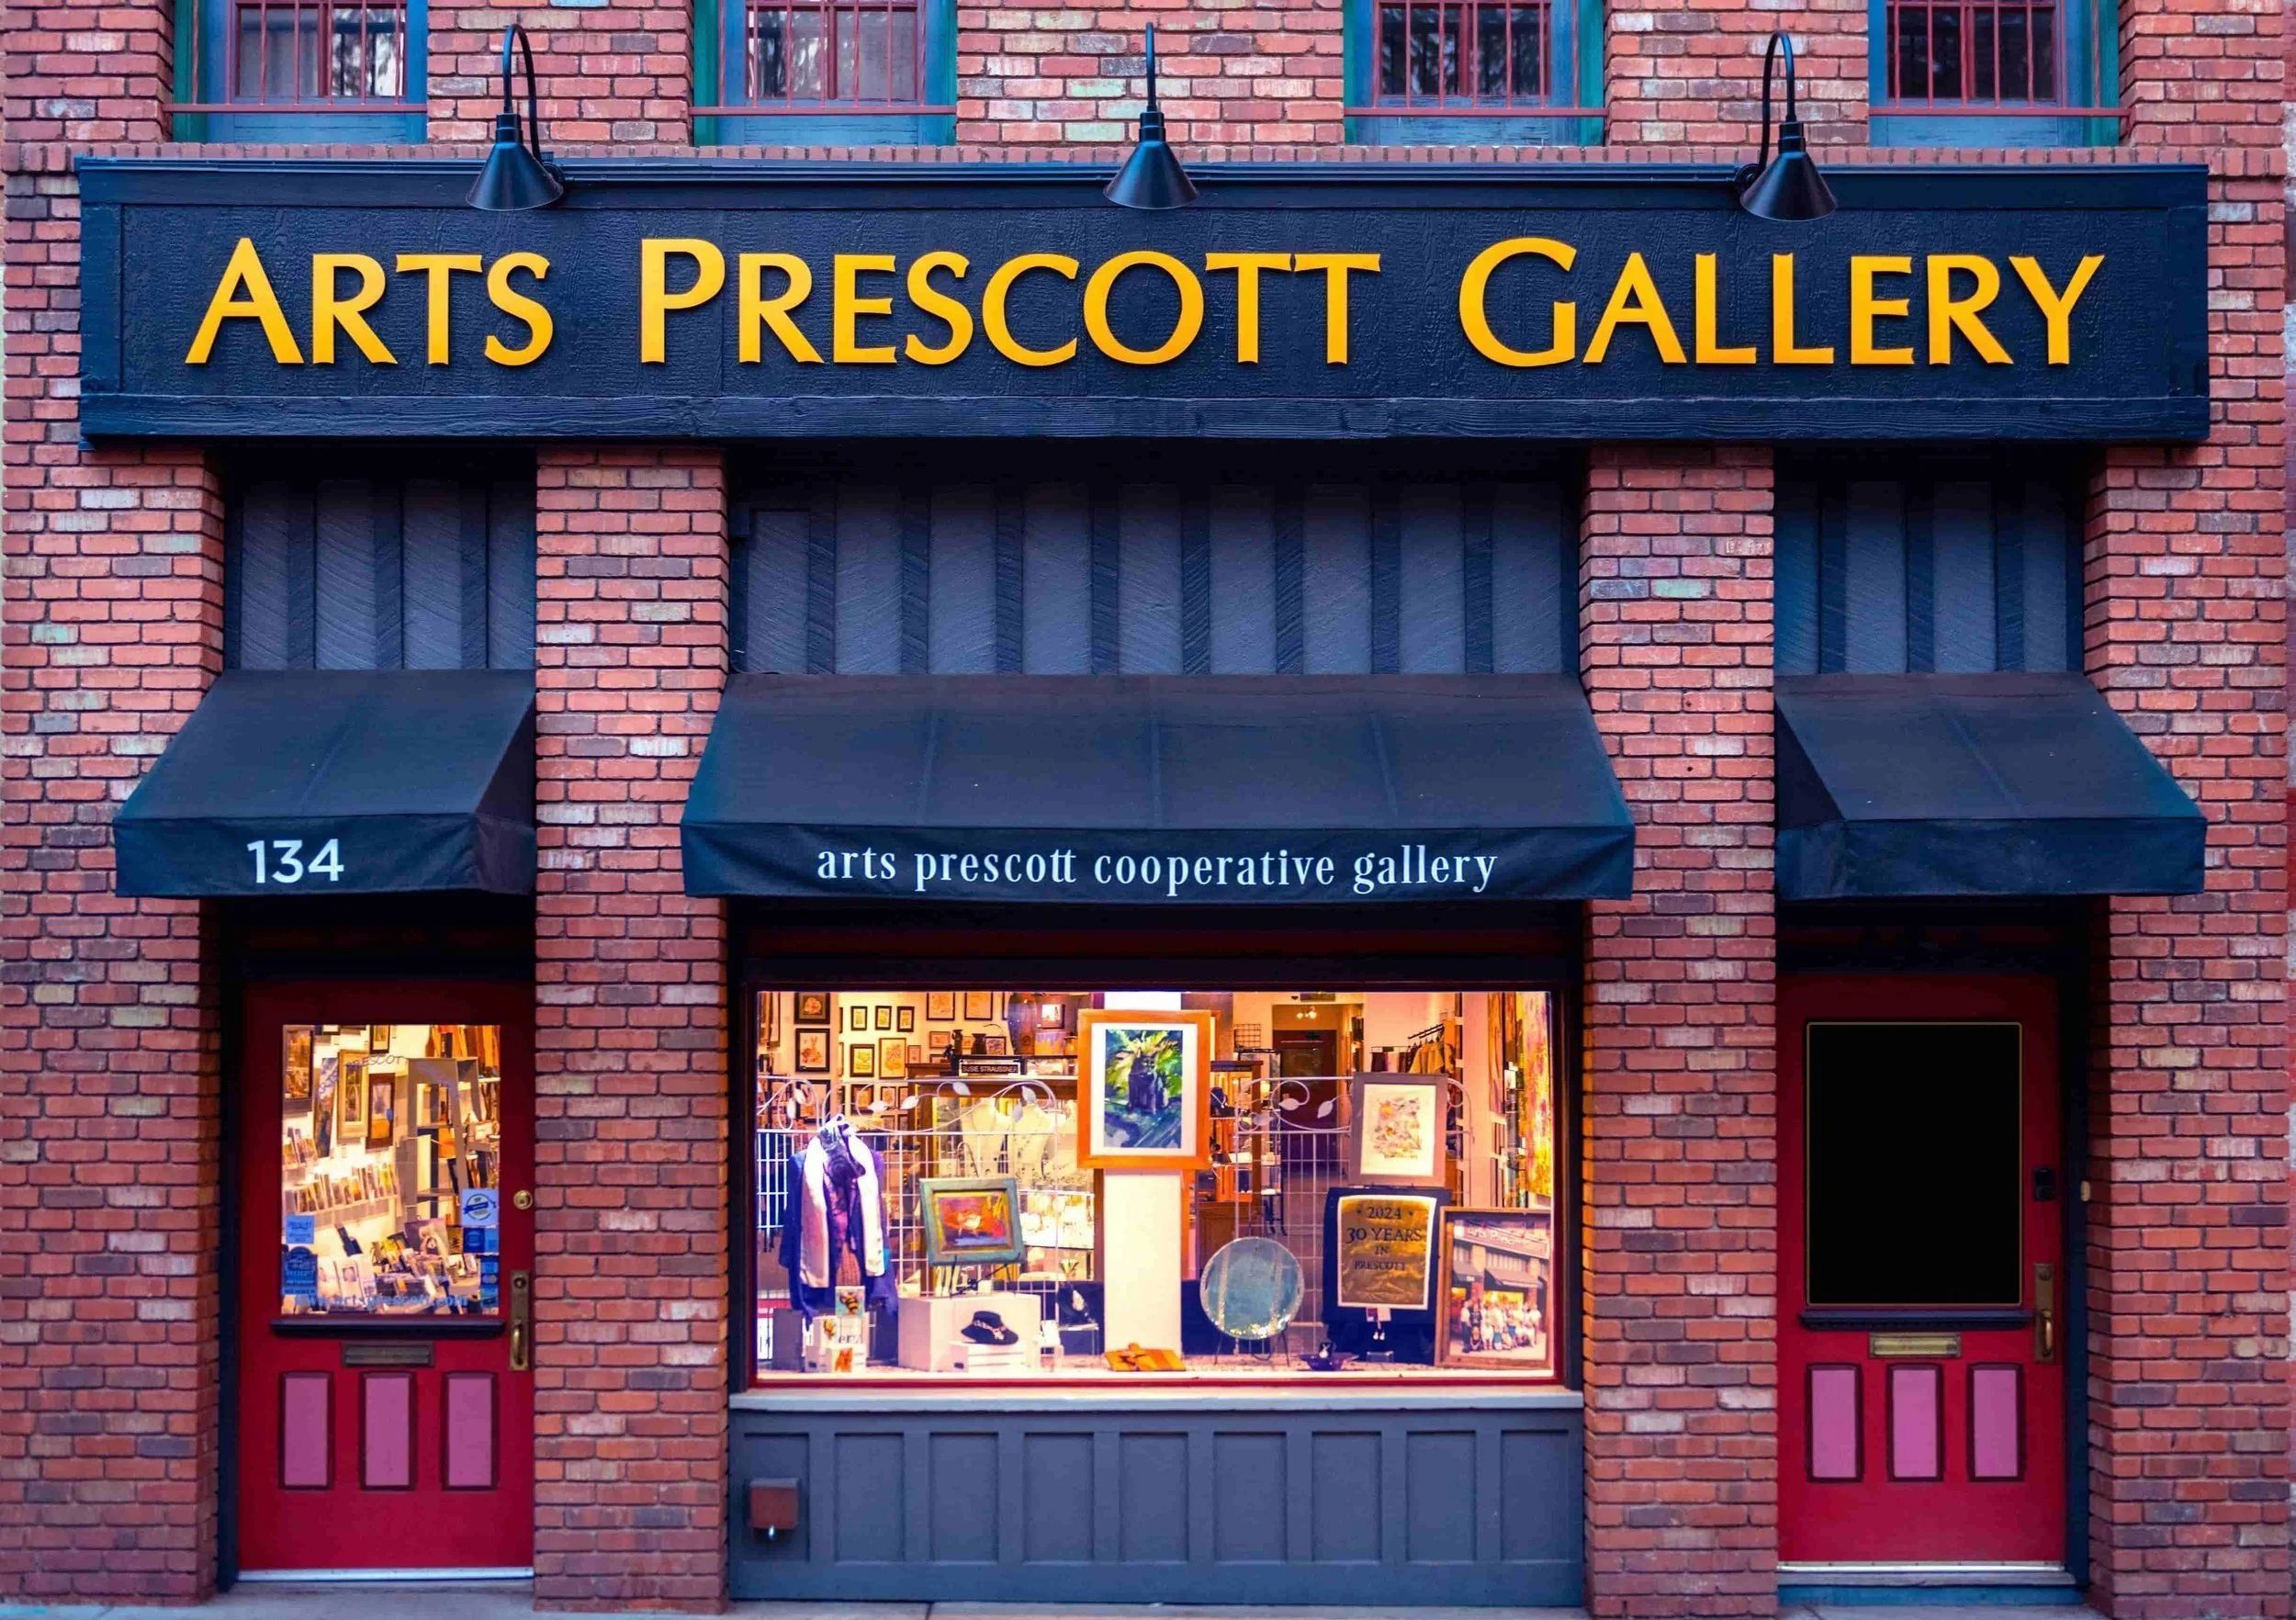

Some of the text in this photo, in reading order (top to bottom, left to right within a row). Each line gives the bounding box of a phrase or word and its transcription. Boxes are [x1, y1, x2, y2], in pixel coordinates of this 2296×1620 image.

[187, 237, 2103, 367] ARTS PRESCOTT GALLERY
[246, 838, 344, 883] 134
[816, 845, 1498, 896] arts prescott cooperative gallery
[1367, 1206, 1401, 1220] 2024
[1345, 1227, 1424, 1244] 30 YEARS
[1375, 1243, 1389, 1255] IN
[1354, 1260, 1405, 1271] PRESCOTT
